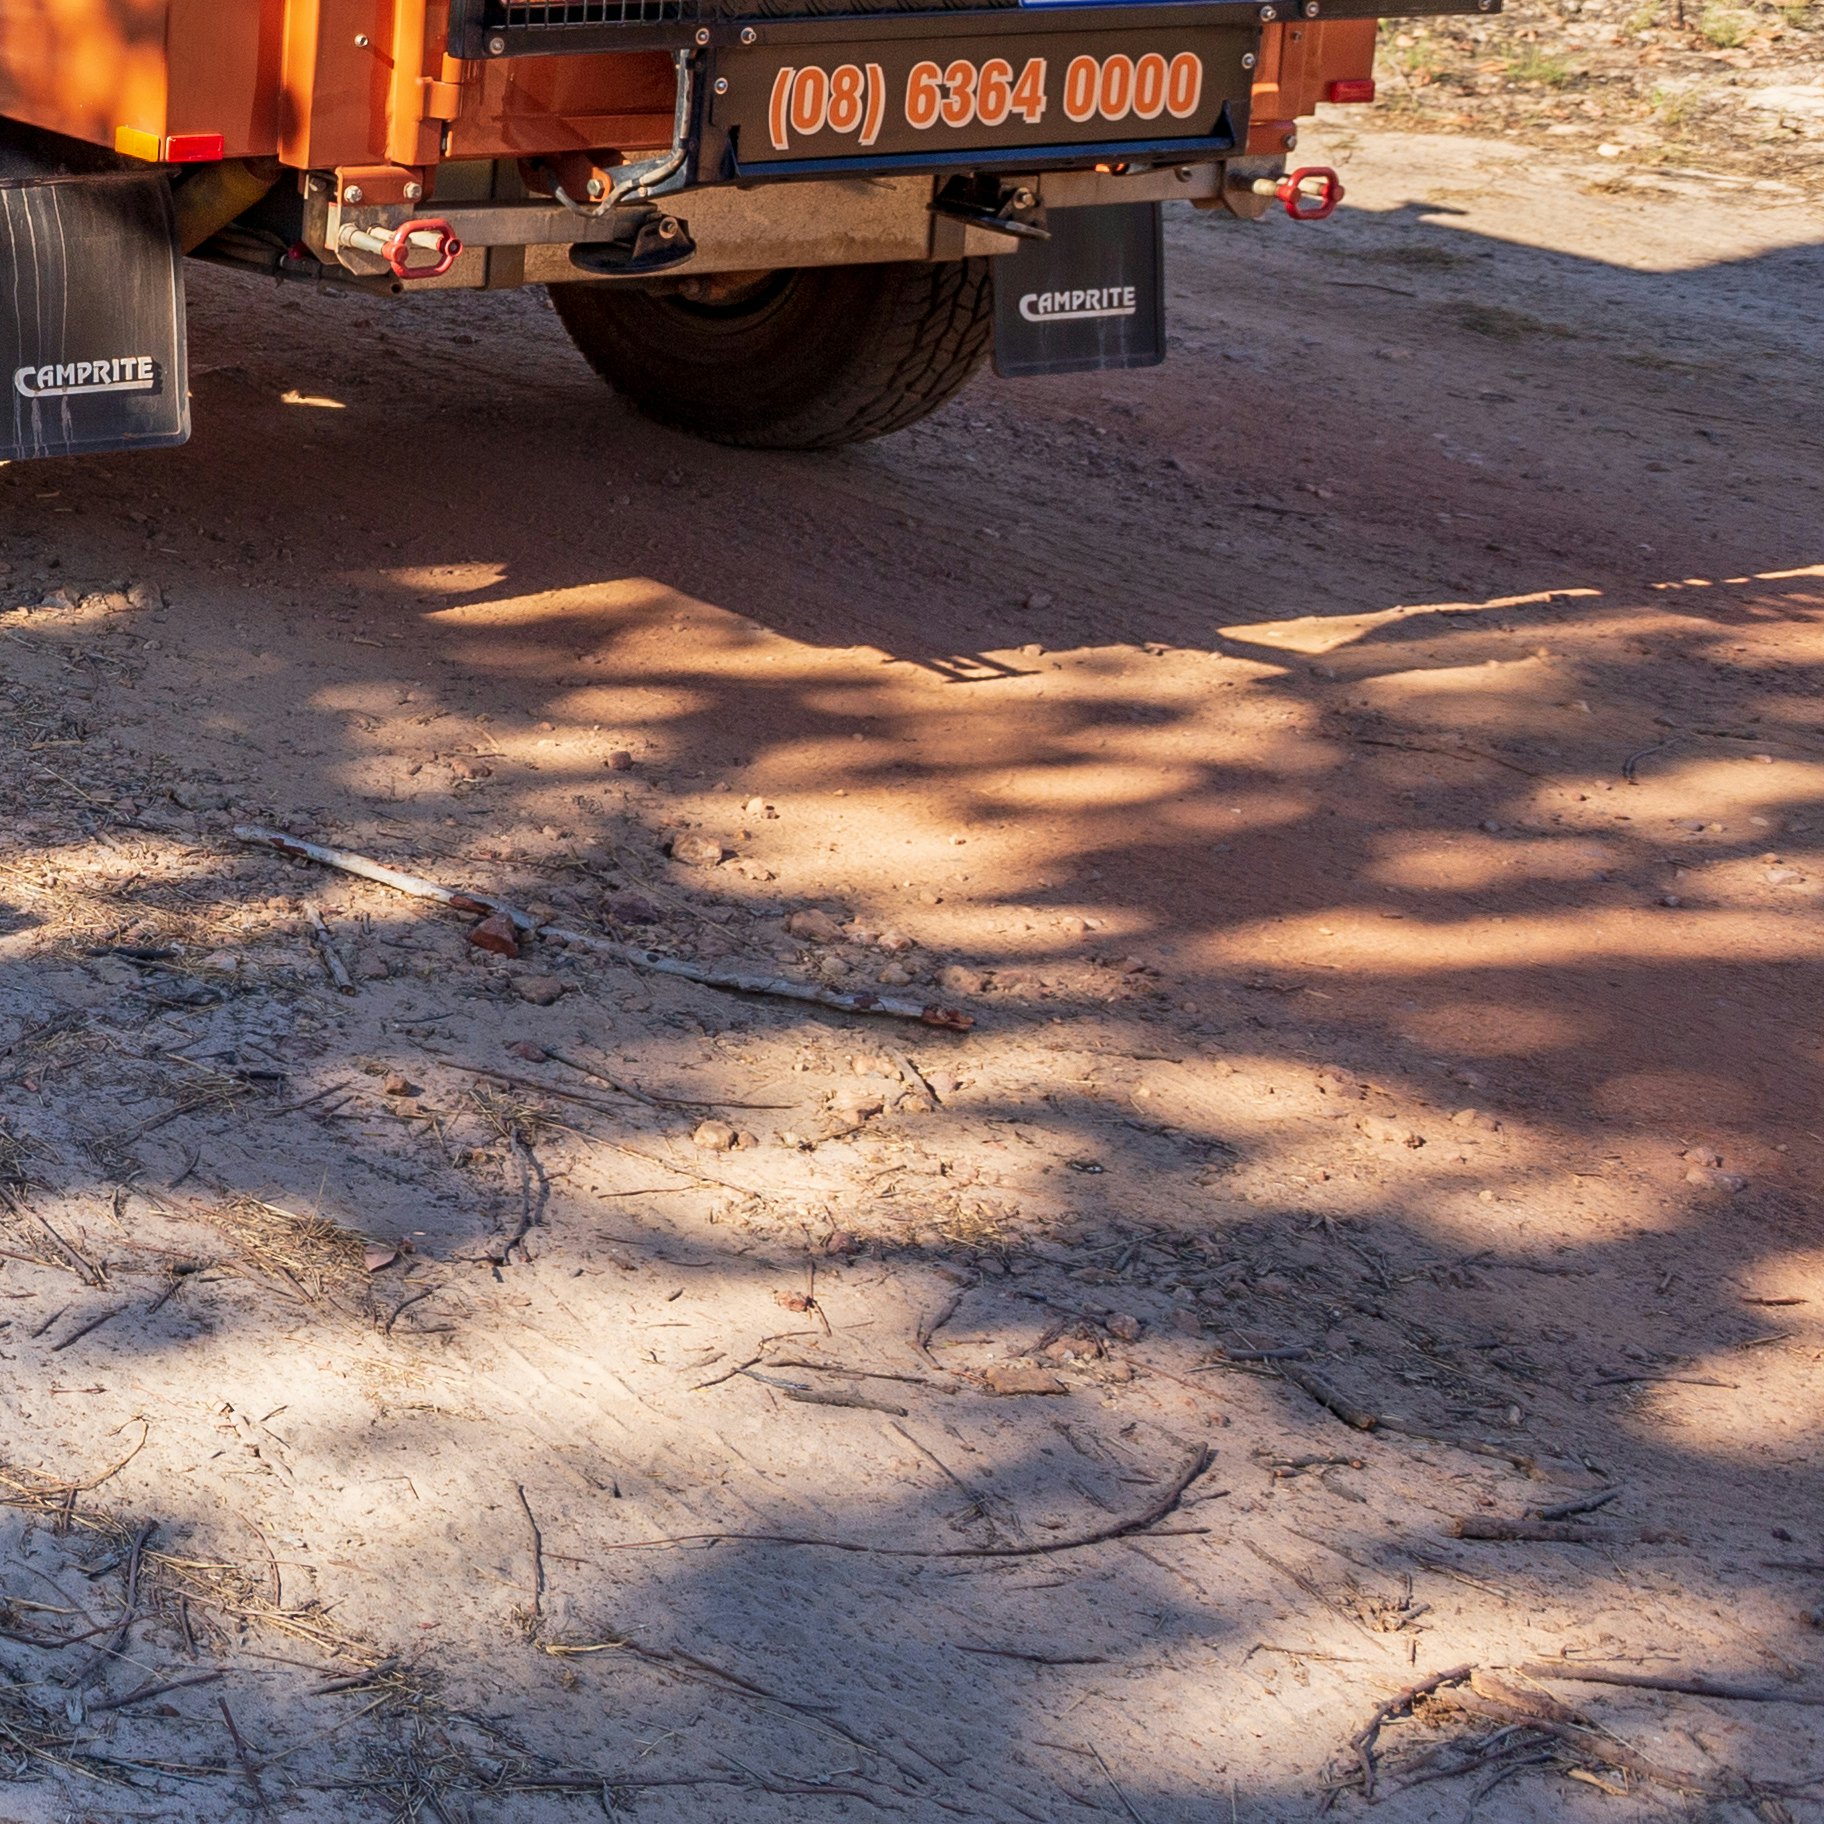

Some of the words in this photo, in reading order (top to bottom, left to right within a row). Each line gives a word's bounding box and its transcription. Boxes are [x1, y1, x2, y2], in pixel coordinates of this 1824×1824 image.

[768, 63, 886, 150] (08)
[905, 57, 1047, 129] 6364
[1063, 51, 1203, 123] 0000
[1019, 286, 1136, 322] CAMPRITE
[14, 356, 154, 397] CAMPRITE
